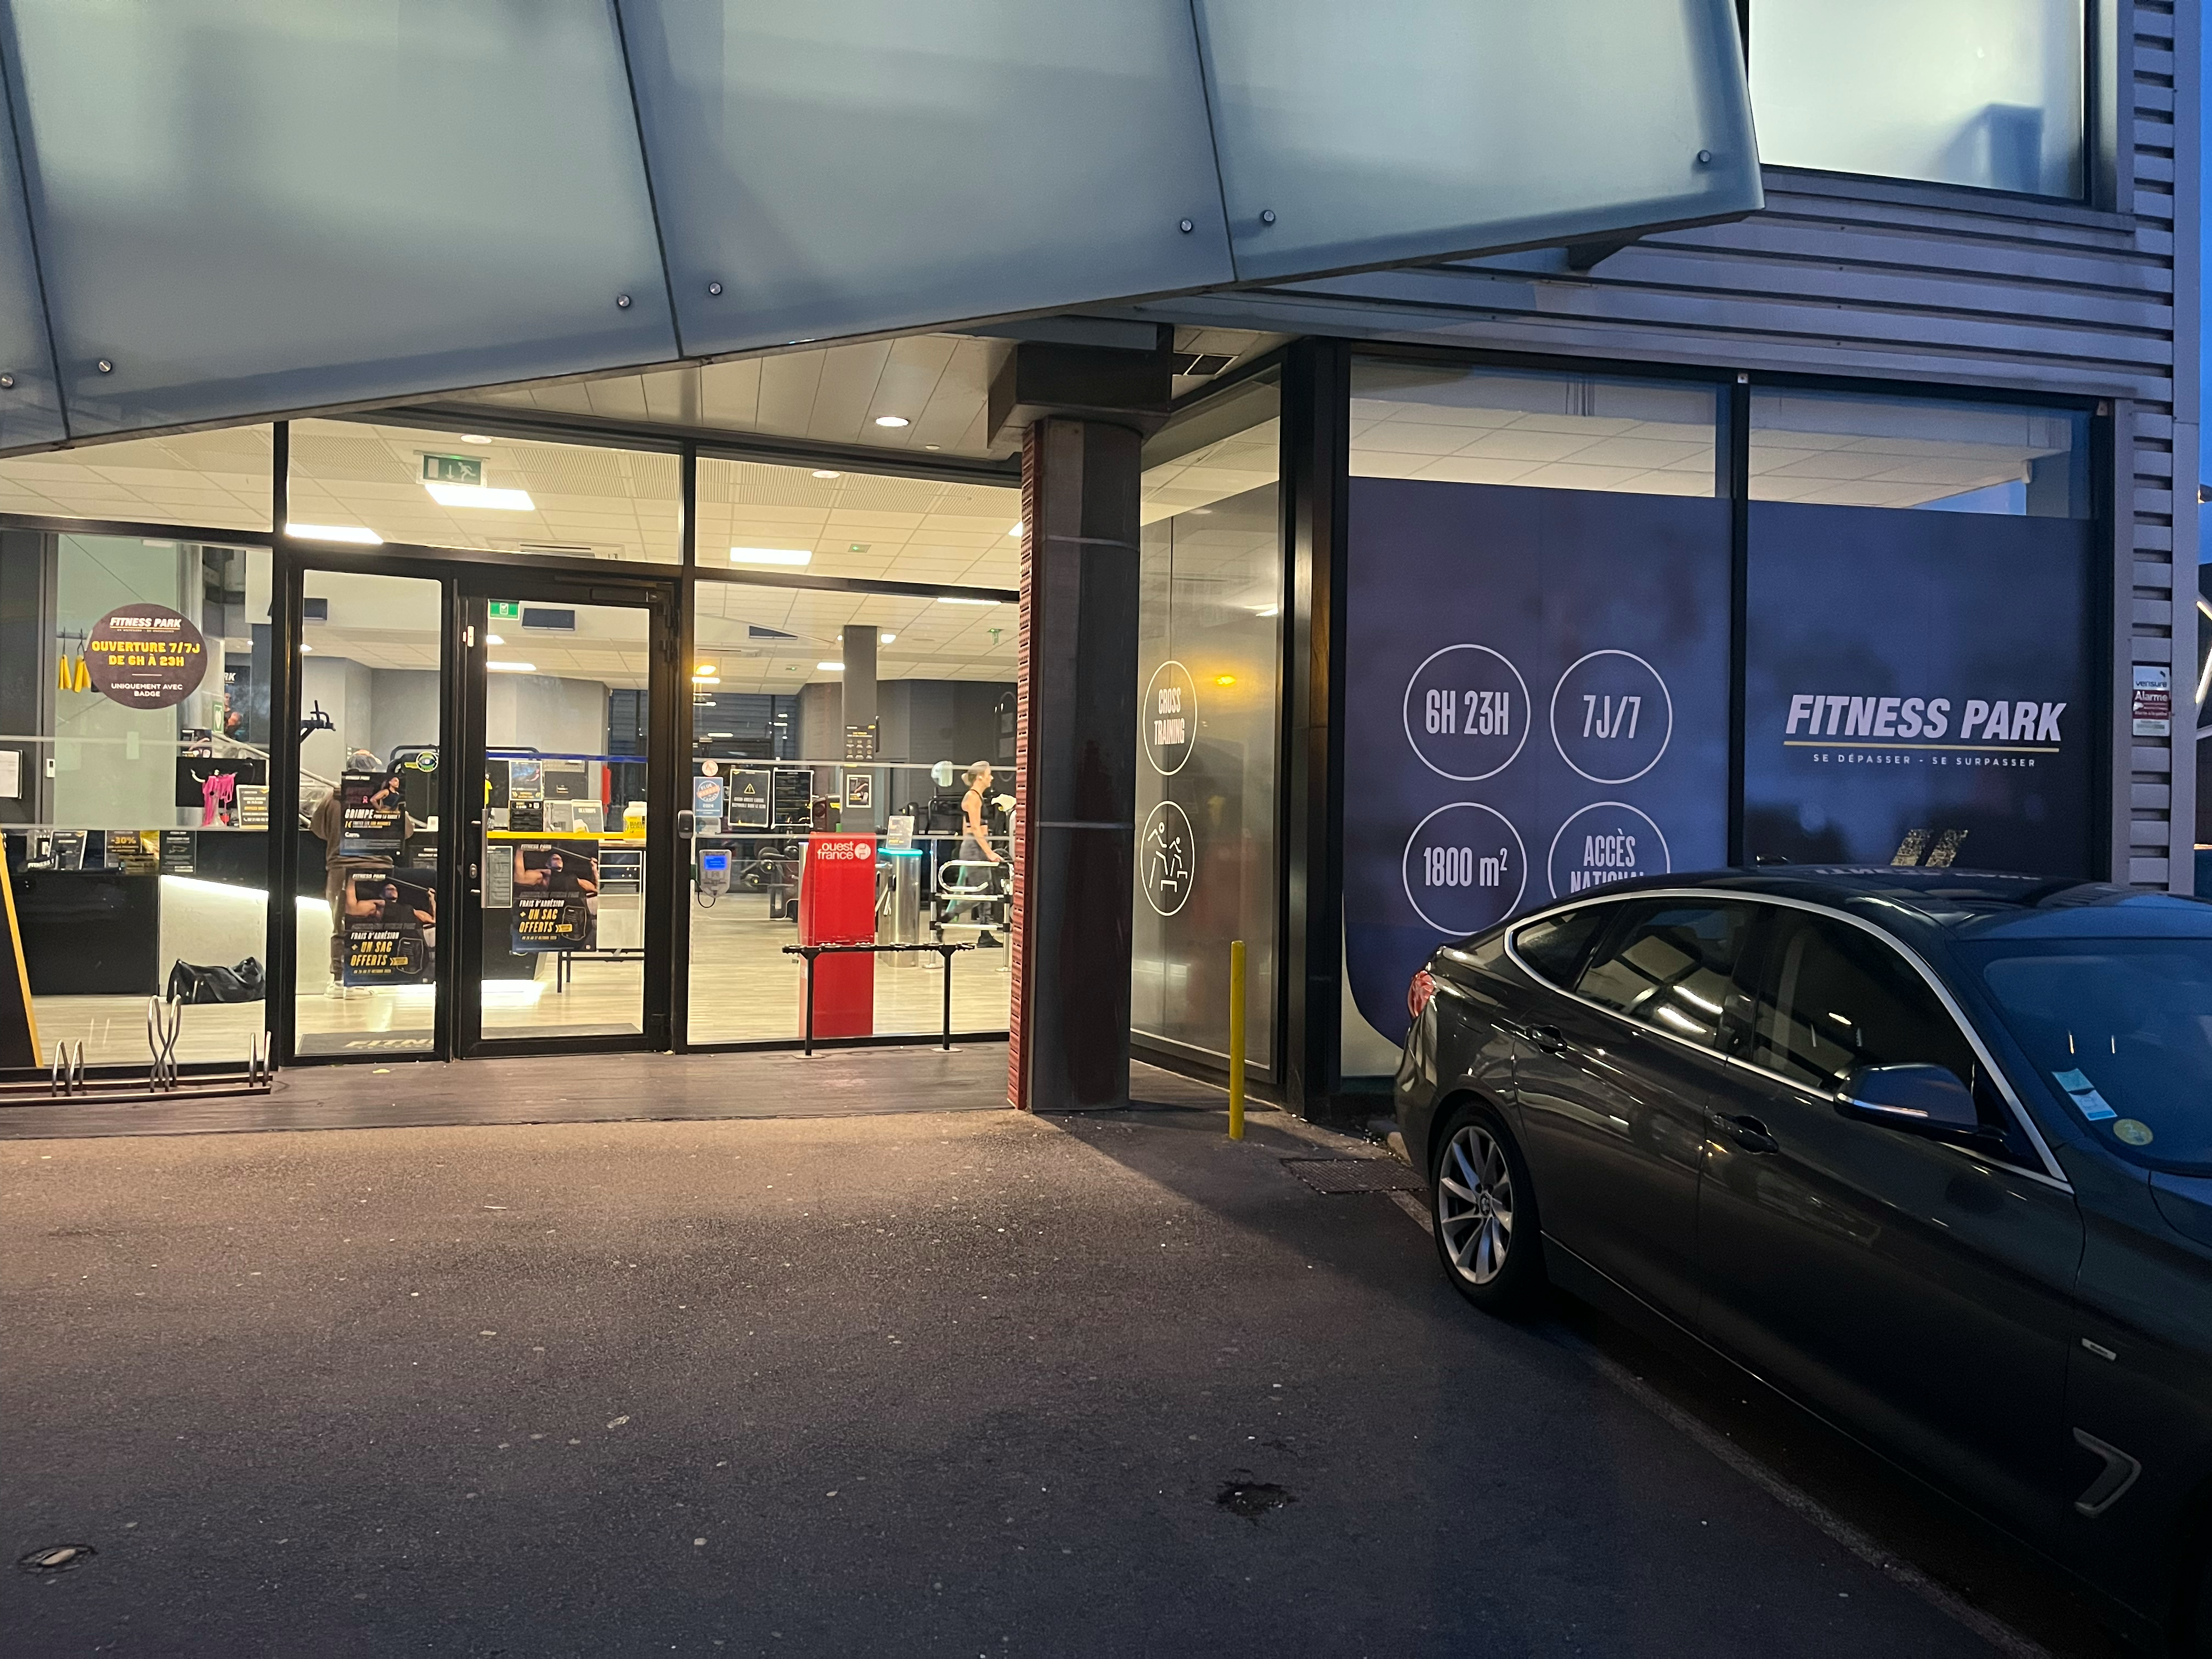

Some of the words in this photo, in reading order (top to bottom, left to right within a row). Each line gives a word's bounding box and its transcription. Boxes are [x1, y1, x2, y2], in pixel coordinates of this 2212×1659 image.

[110, 617, 153, 627] FITNESS
[154, 618, 182, 628] PARK
[92, 641, 166, 652] OUVERTURE
[169, 642, 200, 653] 7/7J
[109, 655, 125, 665] DE
[128, 656, 145, 665] 6H
[148, 653, 156, 666] À
[160, 657, 184, 666] 23H
[1158, 686, 1181, 715] CROSS
[2135, 691, 2168, 702] Alarme
[1426, 690, 1456, 734] 6H
[1464, 691, 1509, 735] 23H
[1583, 695, 1641, 739] 7J/7
[1786, 695, 1950, 738] FITNESS
[1960, 700, 2067, 741] PARK
[1154, 717, 1185, 746] TRAINING
[1813, 754, 1829, 763] SE
[1838, 753, 1911, 764] DÉPASSER
[1932, 757, 1947, 765] SE
[1956, 757, 2035, 768] SURPASSER
[345, 809, 374, 819] GRIMPE
[111, 836, 137, 844] -30%
[821, 842, 854, 851] ouest
[1583, 828, 1635, 867] ACCÈS
[817, 848, 854, 860] france
[1424, 847, 1472, 887] 1800
[528, 909, 540, 920] UN
[541, 909, 558, 920] SAC
[519, 922, 554, 933] OFFERTS
[360, 941, 373, 952] UN
[375, 941, 393, 952] SAC
[350, 954, 388, 966] OFFERTS
